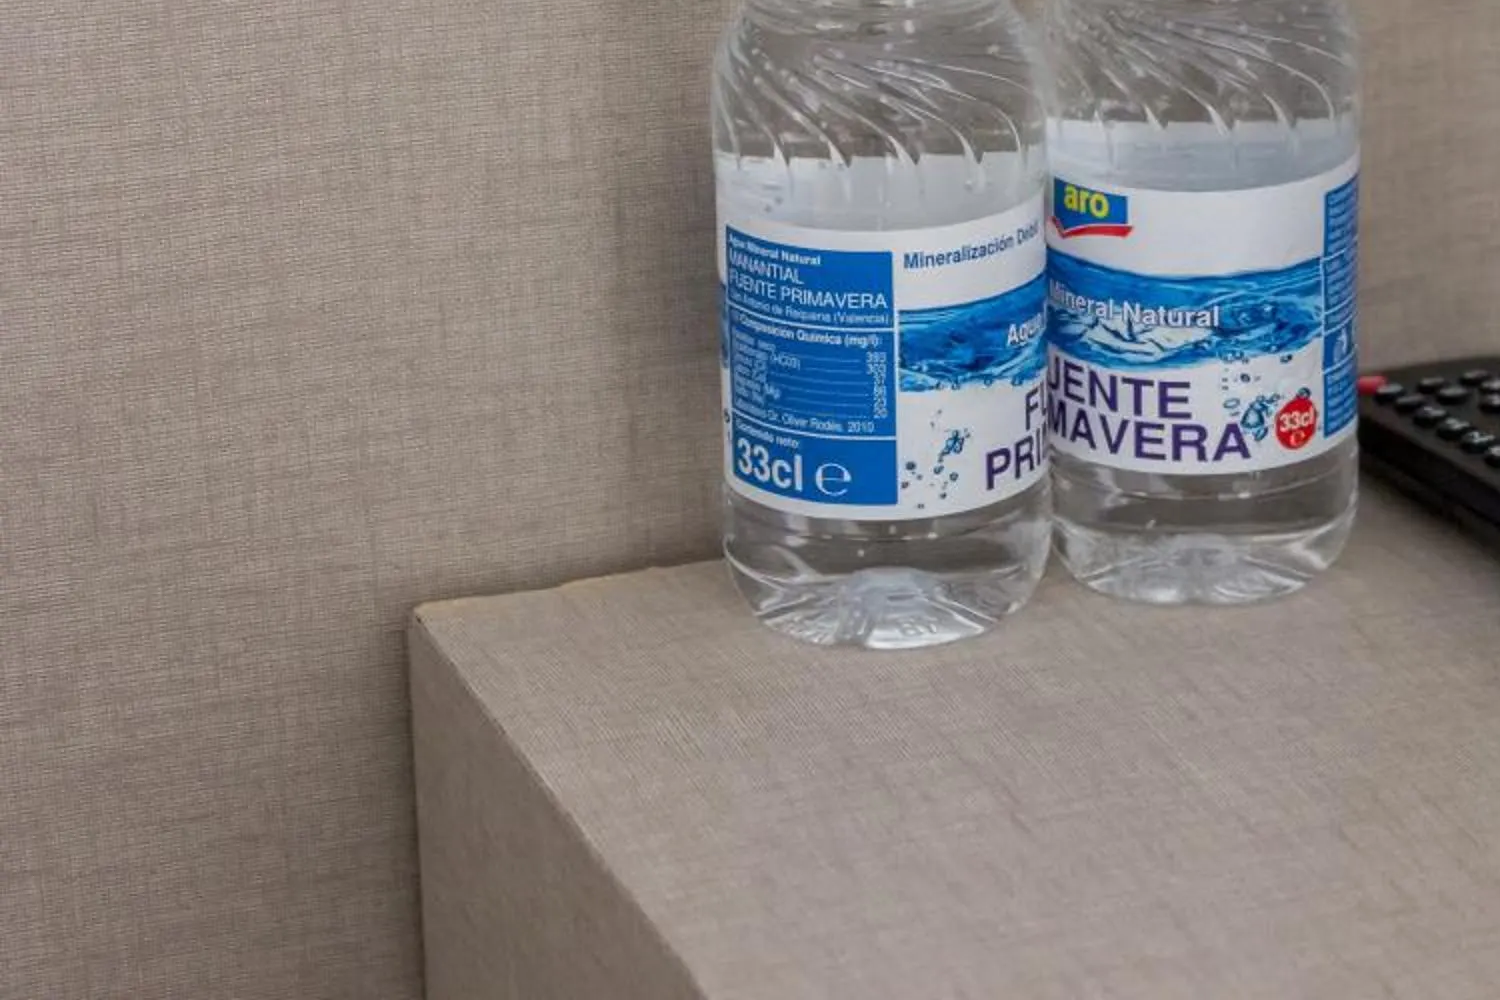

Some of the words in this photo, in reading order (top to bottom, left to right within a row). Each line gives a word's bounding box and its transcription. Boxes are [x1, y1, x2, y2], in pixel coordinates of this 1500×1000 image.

[1063, 184, 1110, 218] aro
[730, 248, 804, 285] MANANTIAL
[782, 251, 821, 266] Natural
[903, 234, 1015, 269] Mineralización
[730, 267, 777, 299] FUENTE
[780, 286, 888, 310] PRIMAVERA
[1120, 302, 1220, 328] Natural
[737, 437, 802, 492] 33cl
